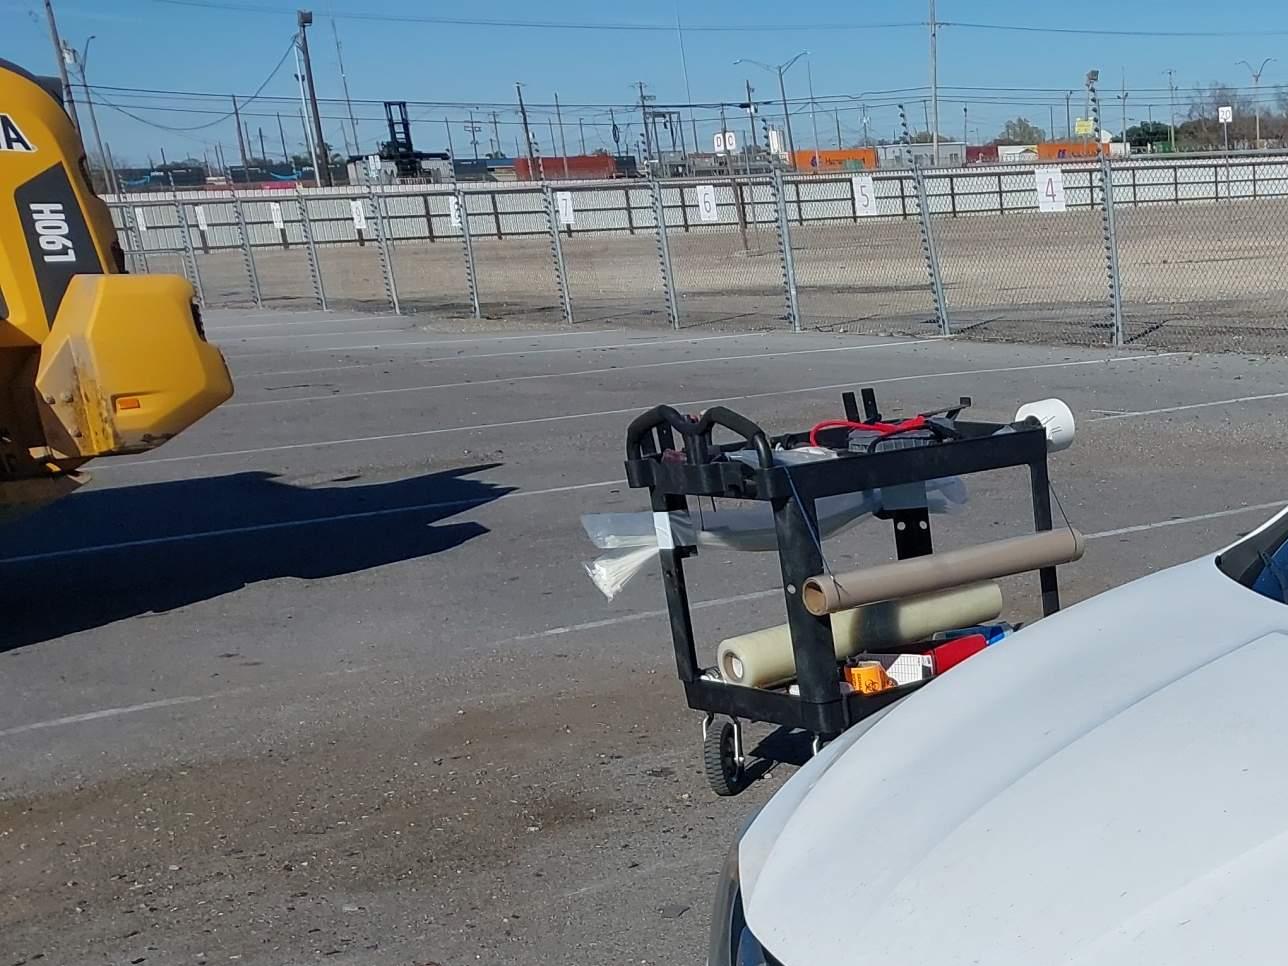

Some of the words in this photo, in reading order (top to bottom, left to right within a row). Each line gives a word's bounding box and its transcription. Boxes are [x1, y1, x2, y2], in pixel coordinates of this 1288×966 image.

[860, 184, 870, 207] 5
[1045, 177, 1056, 202] 4
[561, 198, 568, 217] 7
[703, 192, 711, 213] 6
